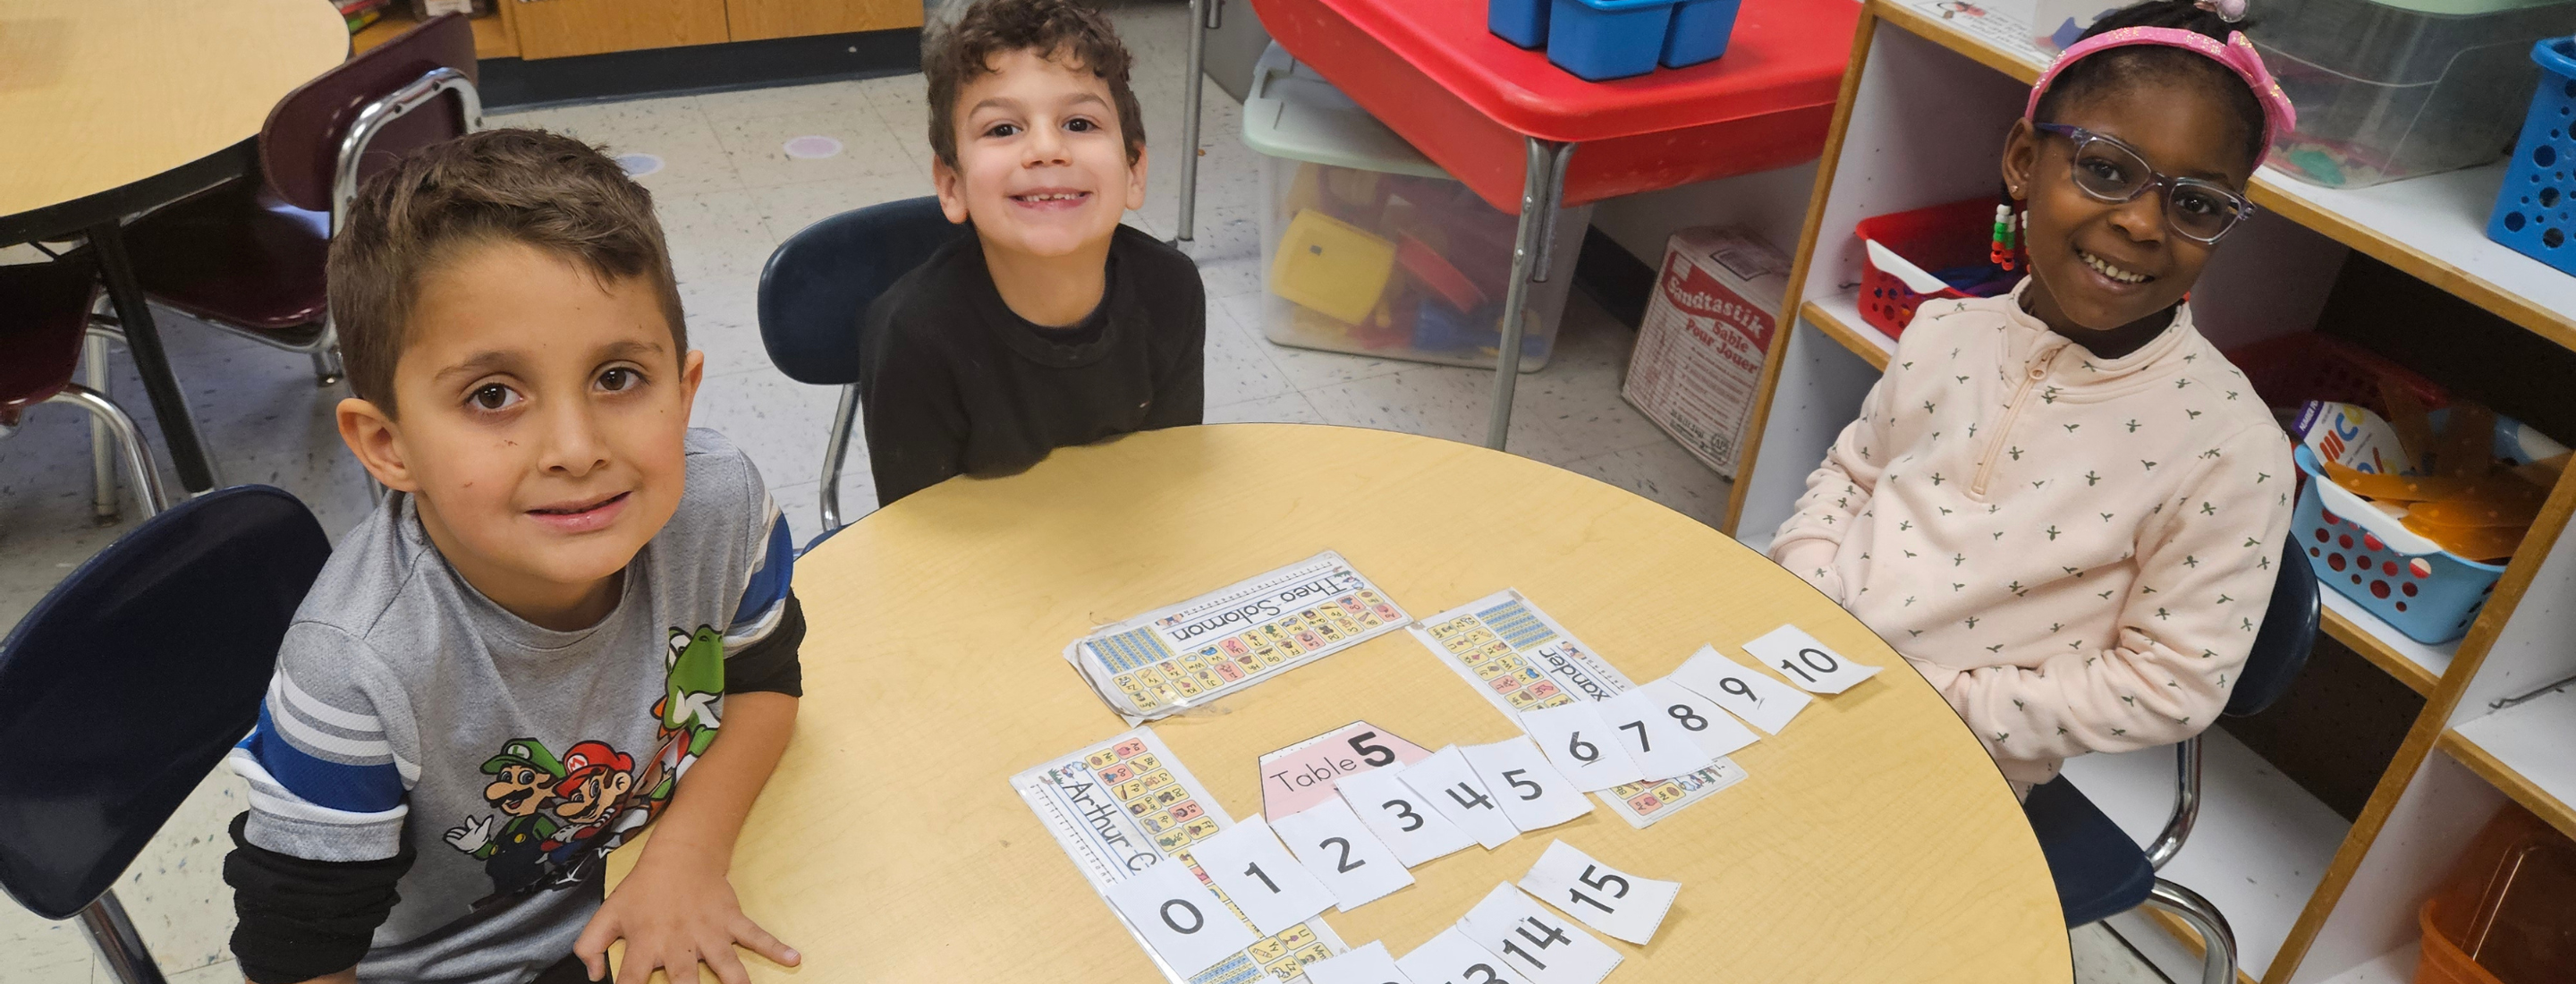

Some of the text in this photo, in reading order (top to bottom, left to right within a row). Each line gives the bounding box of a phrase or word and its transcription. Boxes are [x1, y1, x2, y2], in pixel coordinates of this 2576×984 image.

[1667, 276, 1764, 338] Sandtastik
[1686, 318, 1714, 347] Pour
[1716, 342, 1758, 374] Jouer
[1713, 321, 1749, 352] Sable
[1280, 577, 1347, 603] Theo
[1172, 599, 1281, 640] Solomon
[1781, 648, 1839, 683] 10
[1719, 676, 1758, 702] 9
[1667, 703, 1708, 732] 8
[1131, 742, 1140, 751] Aa
[1569, 730, 1600, 763] 6
[1618, 720, 1651, 753] 7
[512, 746, 524, 757] L
[569, 757, 586, 771] M
[1103, 751, 1113, 762] Nn
[1144, 756, 1154, 767] Bb
[1269, 731, 1396, 793] Table 5
[1117, 768, 1126, 777] Oo
[1158, 772, 1168, 782] Cc
[1501, 768, 1543, 802] 5
[1131, 784, 1140, 793] Pp
[1172, 787, 1184, 798] Dd
[1445, 781, 1495, 810] 4
[1658, 791, 1670, 802] Nn
[1187, 803, 1197, 814] Ee
[1381, 799, 1424, 833] 3
[1635, 802, 1647, 811] Aa
[1062, 783, 1157, 871] Arthur C
[1158, 816, 1169, 824] Rr
[1201, 820, 1215, 829] Ff
[1174, 832, 1183, 842] Ss
[1319, 836, 1367, 874] 2
[1243, 861, 1281, 894] 1
[1568, 864, 1630, 915] 15
[1159, 898, 1204, 935] 0
[1298, 929, 1310, 937] Ll
[1503, 916, 1572, 971] 14
[1268, 941, 1279, 953] Yy
[1285, 960, 1297, 973] Zz
